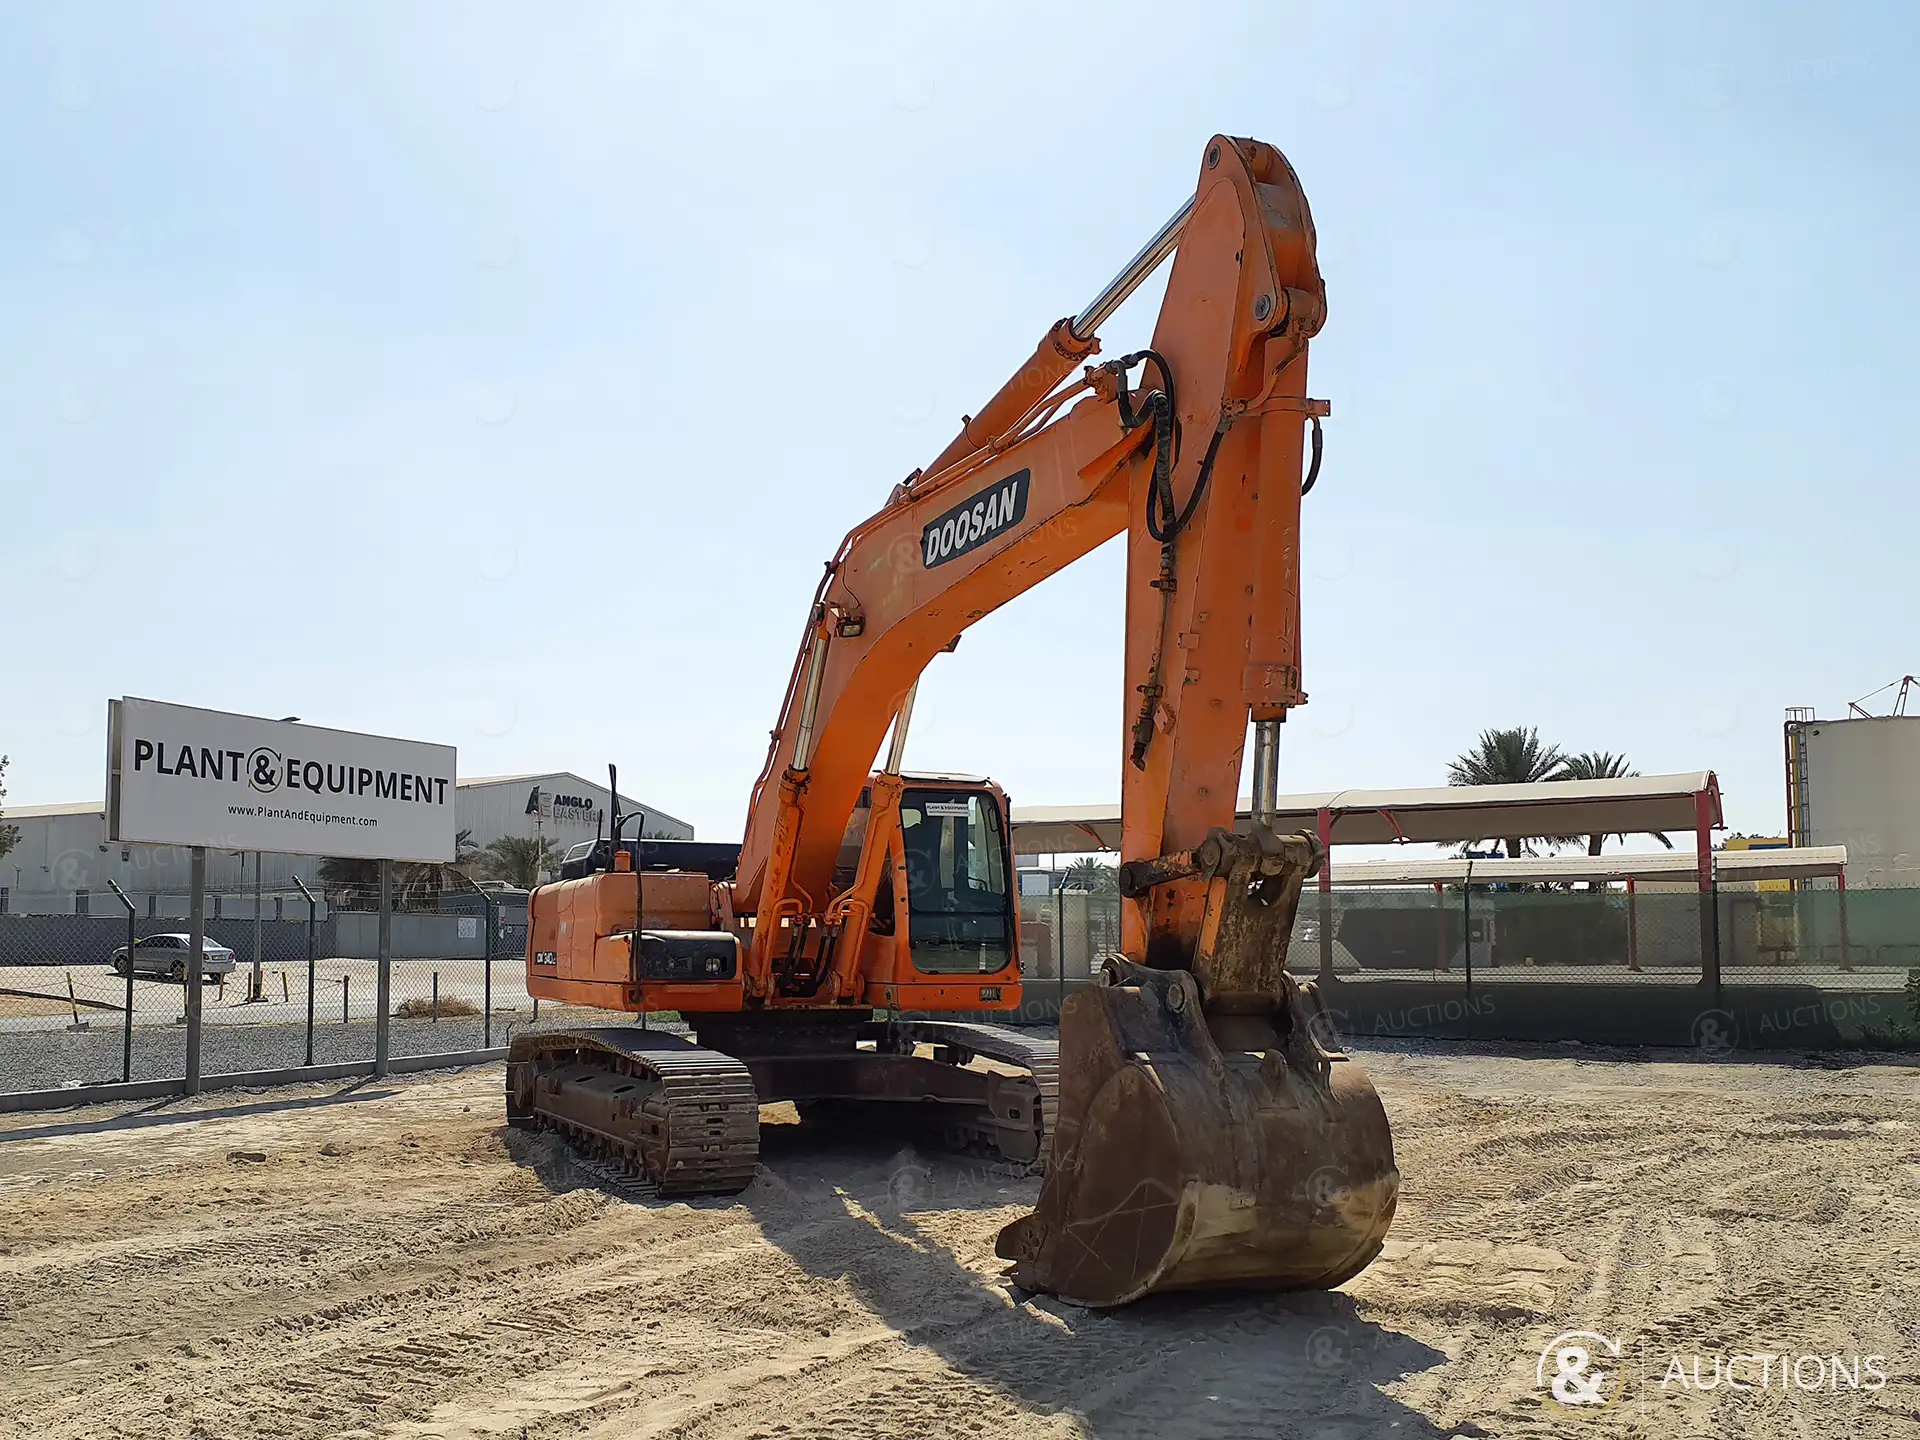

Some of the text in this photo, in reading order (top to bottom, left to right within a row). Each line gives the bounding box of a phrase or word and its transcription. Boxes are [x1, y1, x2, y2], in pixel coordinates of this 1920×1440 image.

[926, 481, 1018, 566] DOOSAN
[134, 738, 245, 782] PLANT
[287, 758, 449, 805] EQUIPMENT
[227, 804, 378, 827] www.PlantAndEquipment.com
[553, 793, 593, 810] ANGLO
